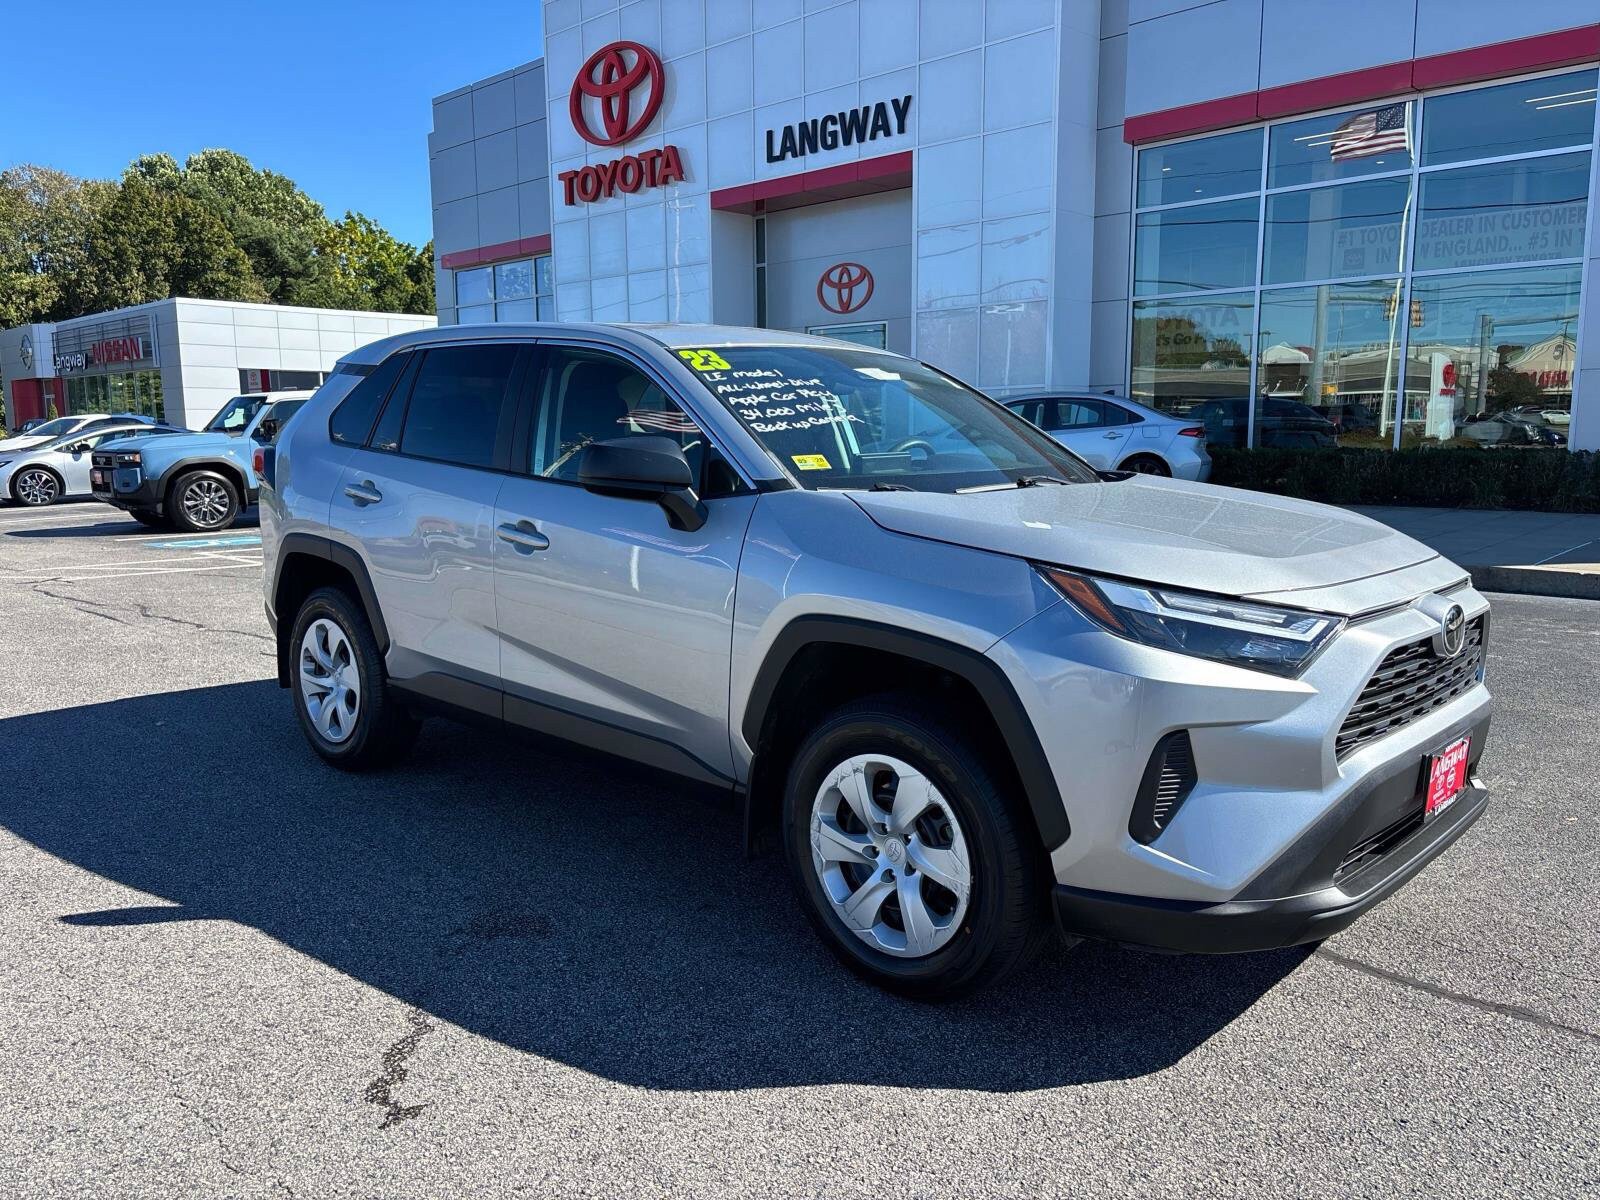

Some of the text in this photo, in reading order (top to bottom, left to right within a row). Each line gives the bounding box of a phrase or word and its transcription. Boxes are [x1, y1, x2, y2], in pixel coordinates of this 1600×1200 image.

[766, 95, 912, 163] LANGWAY
[558, 145, 685, 206] TOYOTA
[1337, 231, 1354, 248] #1
[1479, 213, 1497, 233] IN
[1375, 247, 1392, 264] IN
[1528, 231, 1549, 249] #5
[1554, 228, 1574, 247] IN
[53, 335, 144, 372] Langway NISSAN
[1173, 332, 1192, 345] Go
[678, 350, 731, 371] 23
[703, 372, 727, 381] LE
[728, 394, 769, 406] Apple
[1429, 740, 1469, 783] LANGWAY
